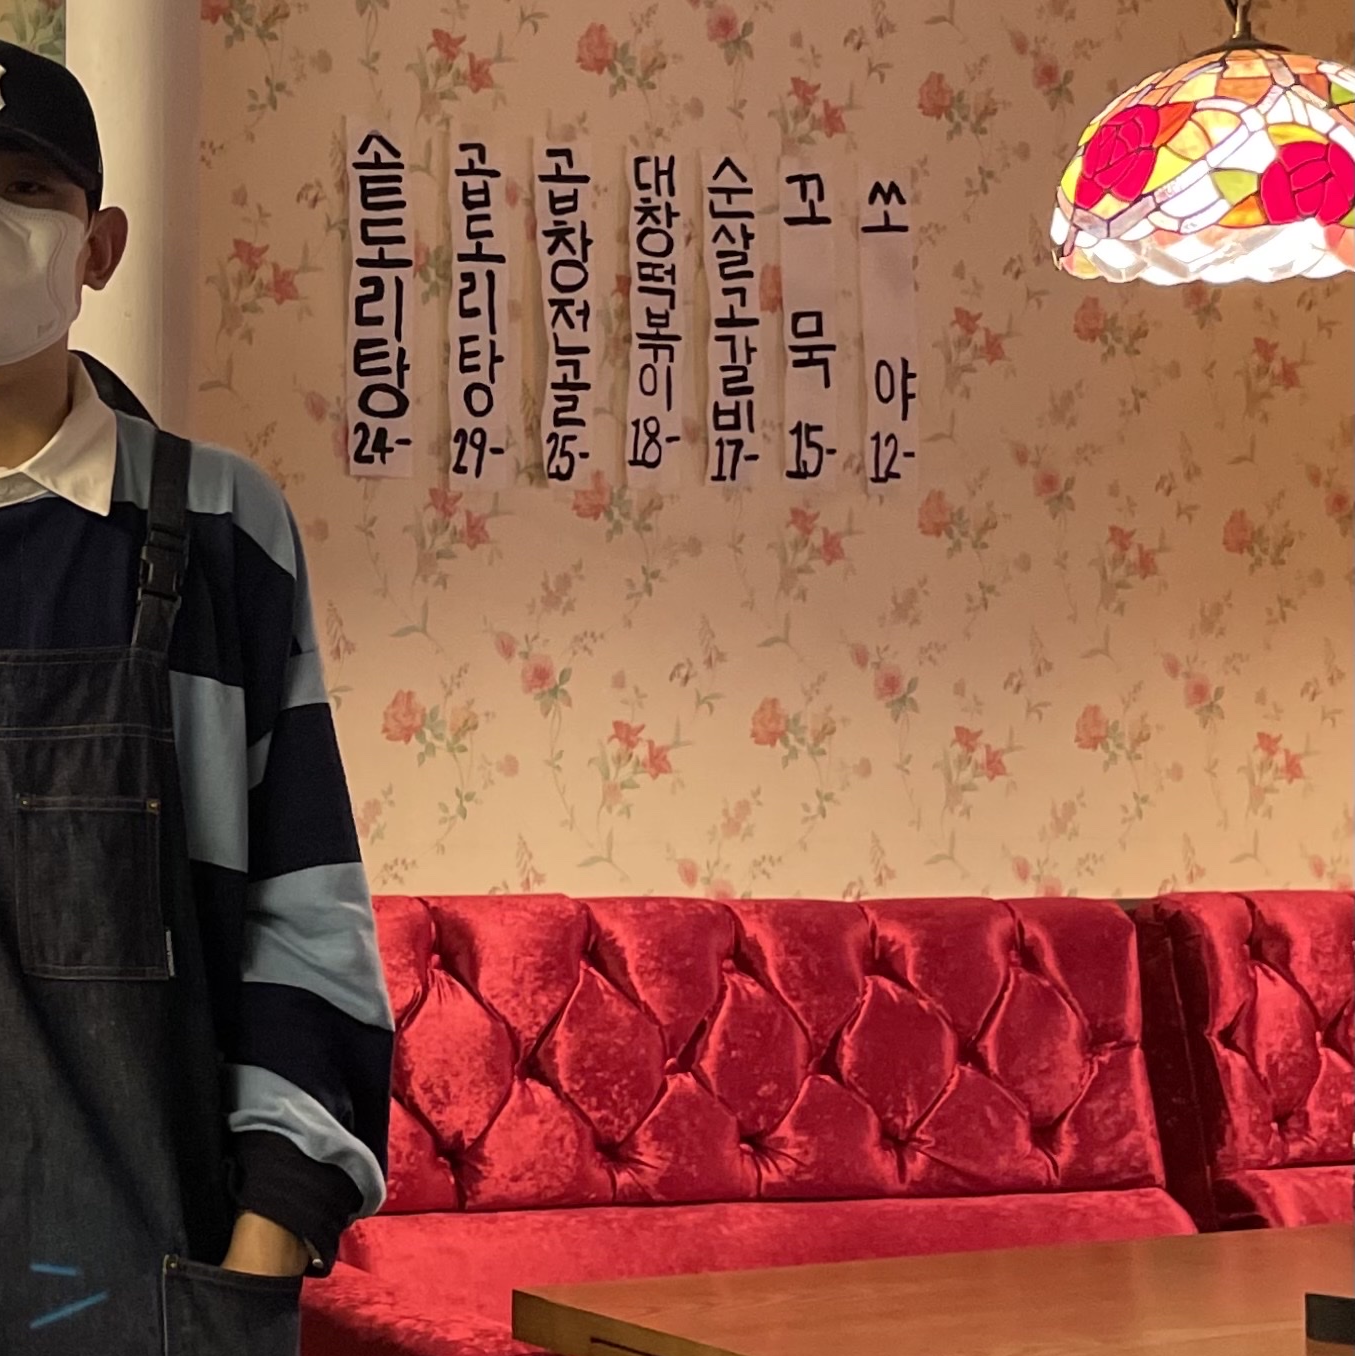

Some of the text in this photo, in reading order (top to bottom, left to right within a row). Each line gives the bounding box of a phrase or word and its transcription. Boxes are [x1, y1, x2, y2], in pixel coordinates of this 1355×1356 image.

[352, 131, 413, 419] 솥도리탕
[455, 142, 506, 418] 곱도리탕
[538, 148, 593, 427] 곱창전골
[633, 154, 682, 412] 대창떡볶이
[707, 156, 760, 433] 순살고갈비
